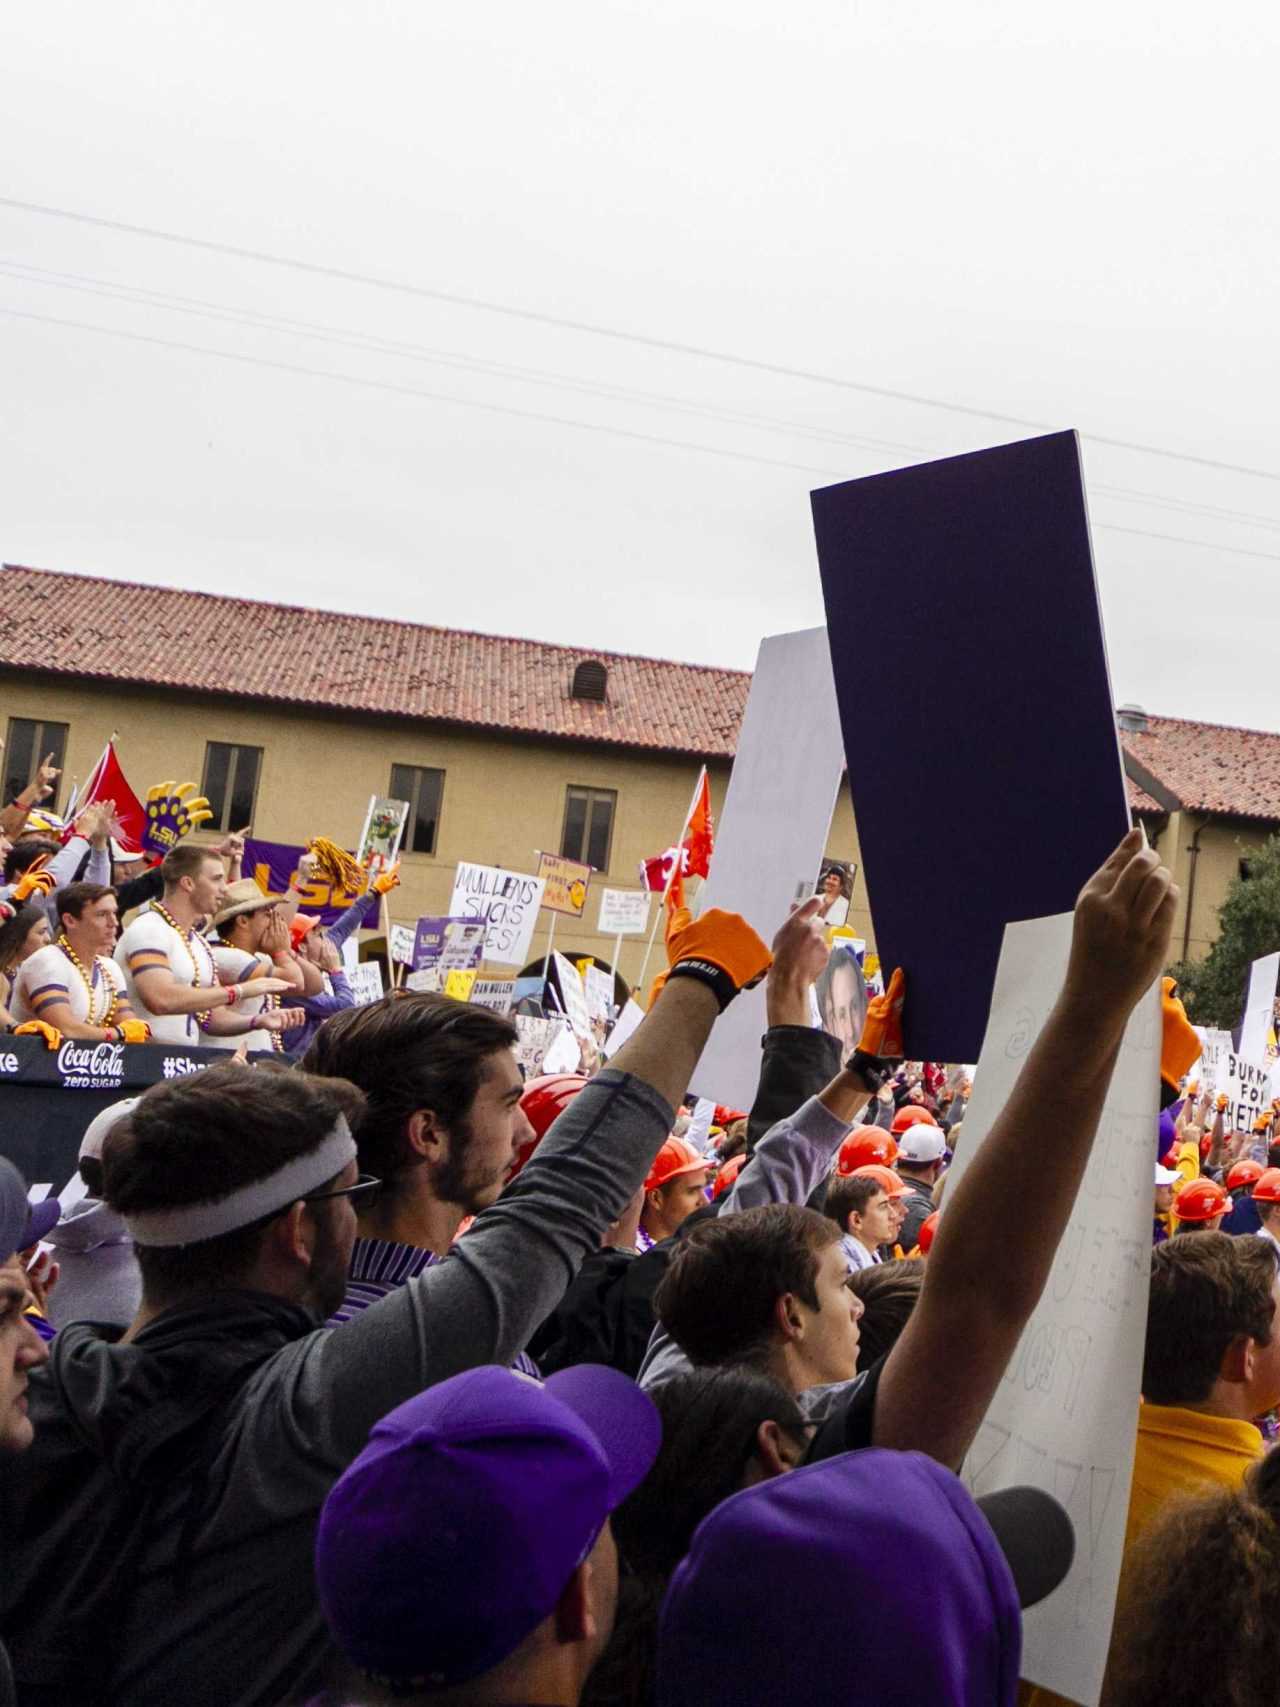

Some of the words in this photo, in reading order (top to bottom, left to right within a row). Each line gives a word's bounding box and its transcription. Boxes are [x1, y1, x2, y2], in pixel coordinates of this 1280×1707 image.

[151, 823, 177, 844] LSU
[462, 897, 524, 924] SUCKS
[57, 1040, 124, 1076] Coca-Cola
[63, 1075, 90, 1088] zero
[91, 1078, 121, 1088] SUGAR
